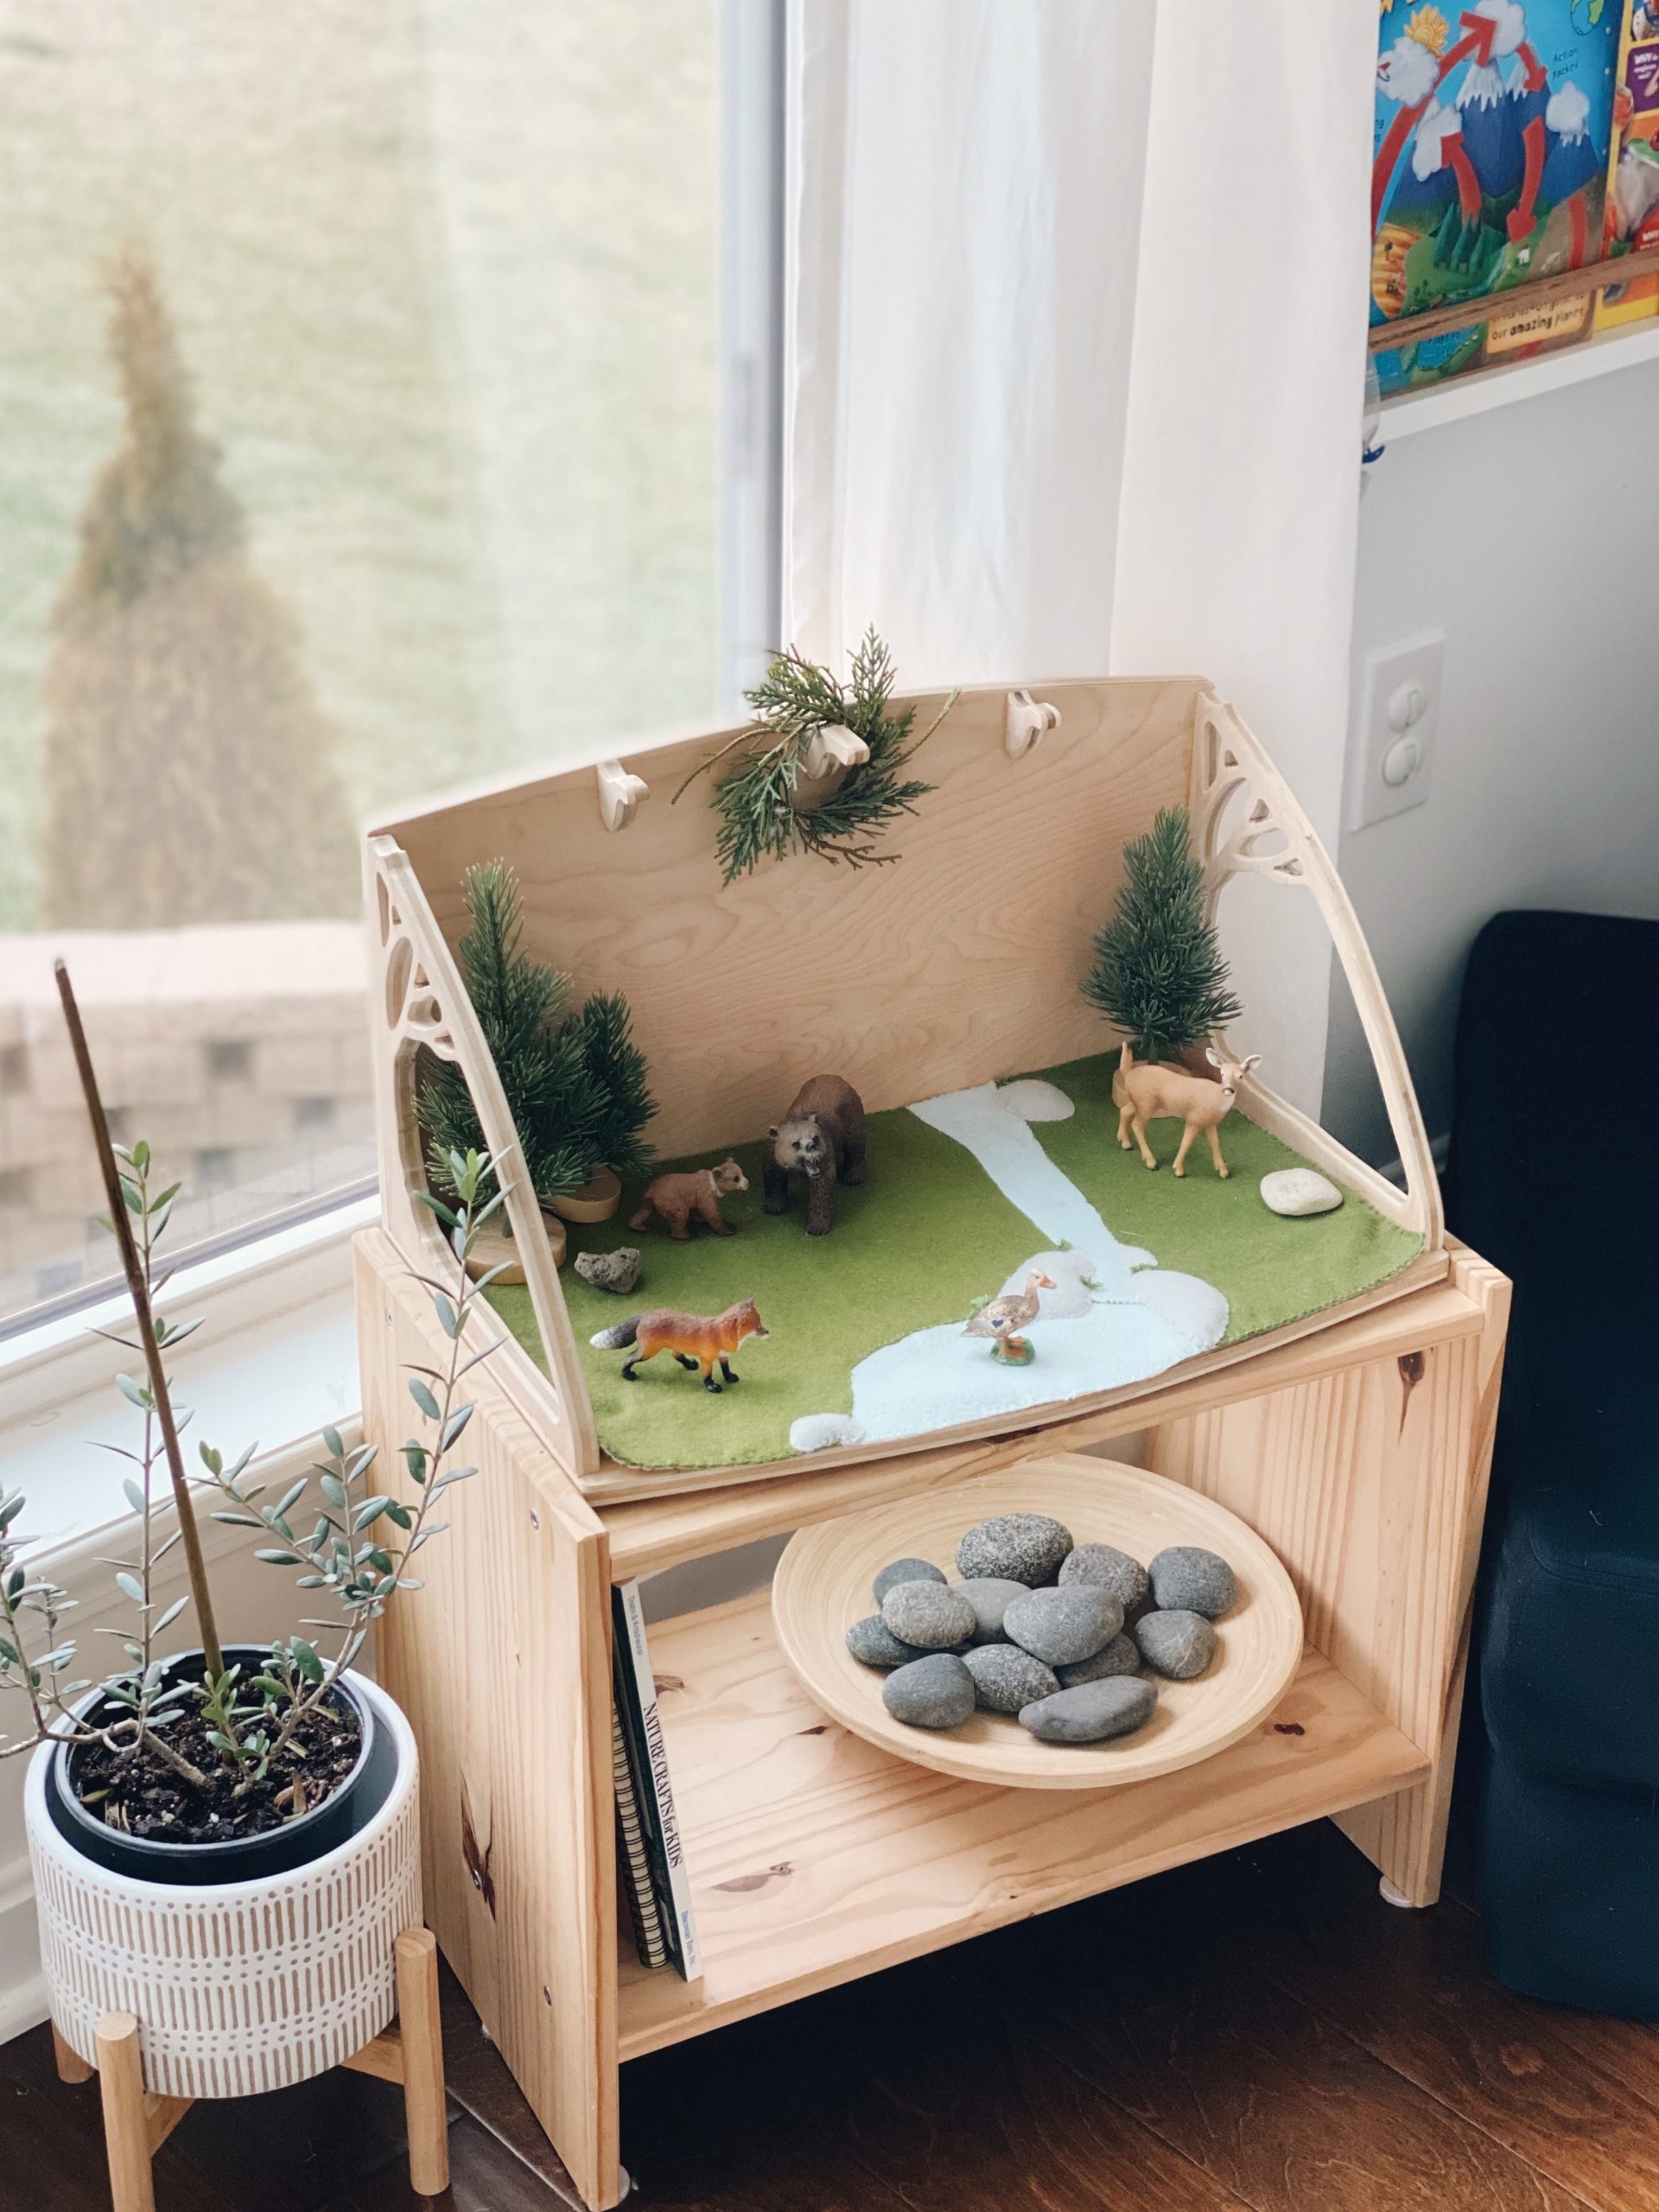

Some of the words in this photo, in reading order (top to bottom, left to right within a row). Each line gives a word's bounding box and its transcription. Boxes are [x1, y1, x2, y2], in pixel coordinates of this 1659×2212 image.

[1553, 48, 1579, 63] Action
[1634, 52, 1653, 66] WHY
[1492, 328, 1508, 340] our
[1510, 315, 1553, 336] amazing
[1554, 306, 1585, 327] planet
[643, 1702, 665, 1764] NATURE
[654, 1760, 675, 1818] CRAFTS
[662, 1815, 677, 1834] for
[665, 1831, 683, 1869] KIDS
